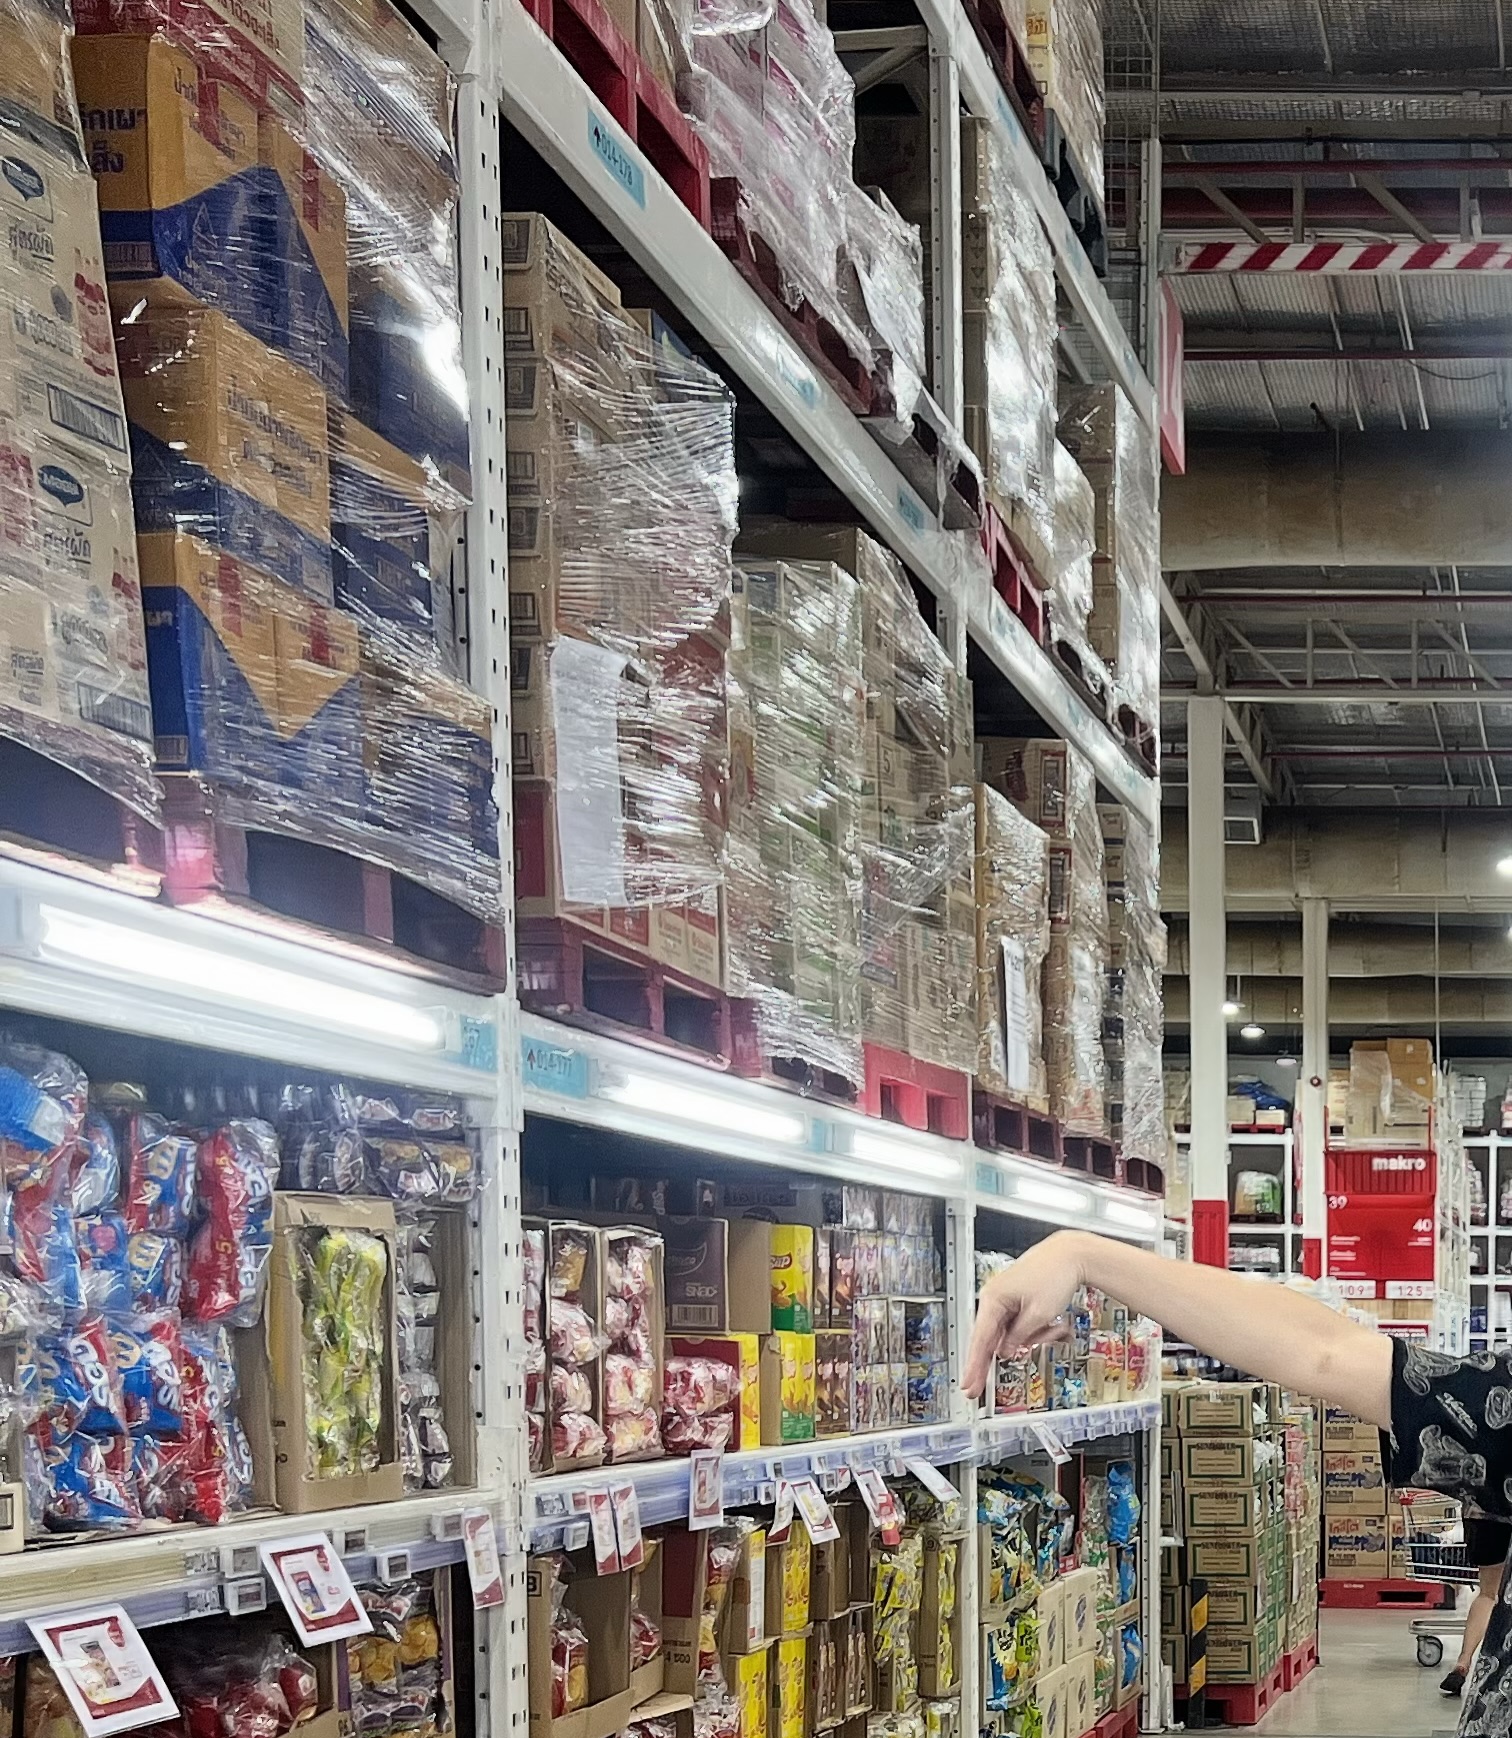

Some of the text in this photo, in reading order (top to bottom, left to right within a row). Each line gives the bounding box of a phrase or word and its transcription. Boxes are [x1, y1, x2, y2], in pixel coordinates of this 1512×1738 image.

[1371, 1154, 1427, 1171] makro
[1328, 1195, 1348, 1210] 39
[1412, 1218, 1433, 1233] 40
[1338, 1285, 1365, 1296] 109
[1398, 1285, 1423, 1297] 125
